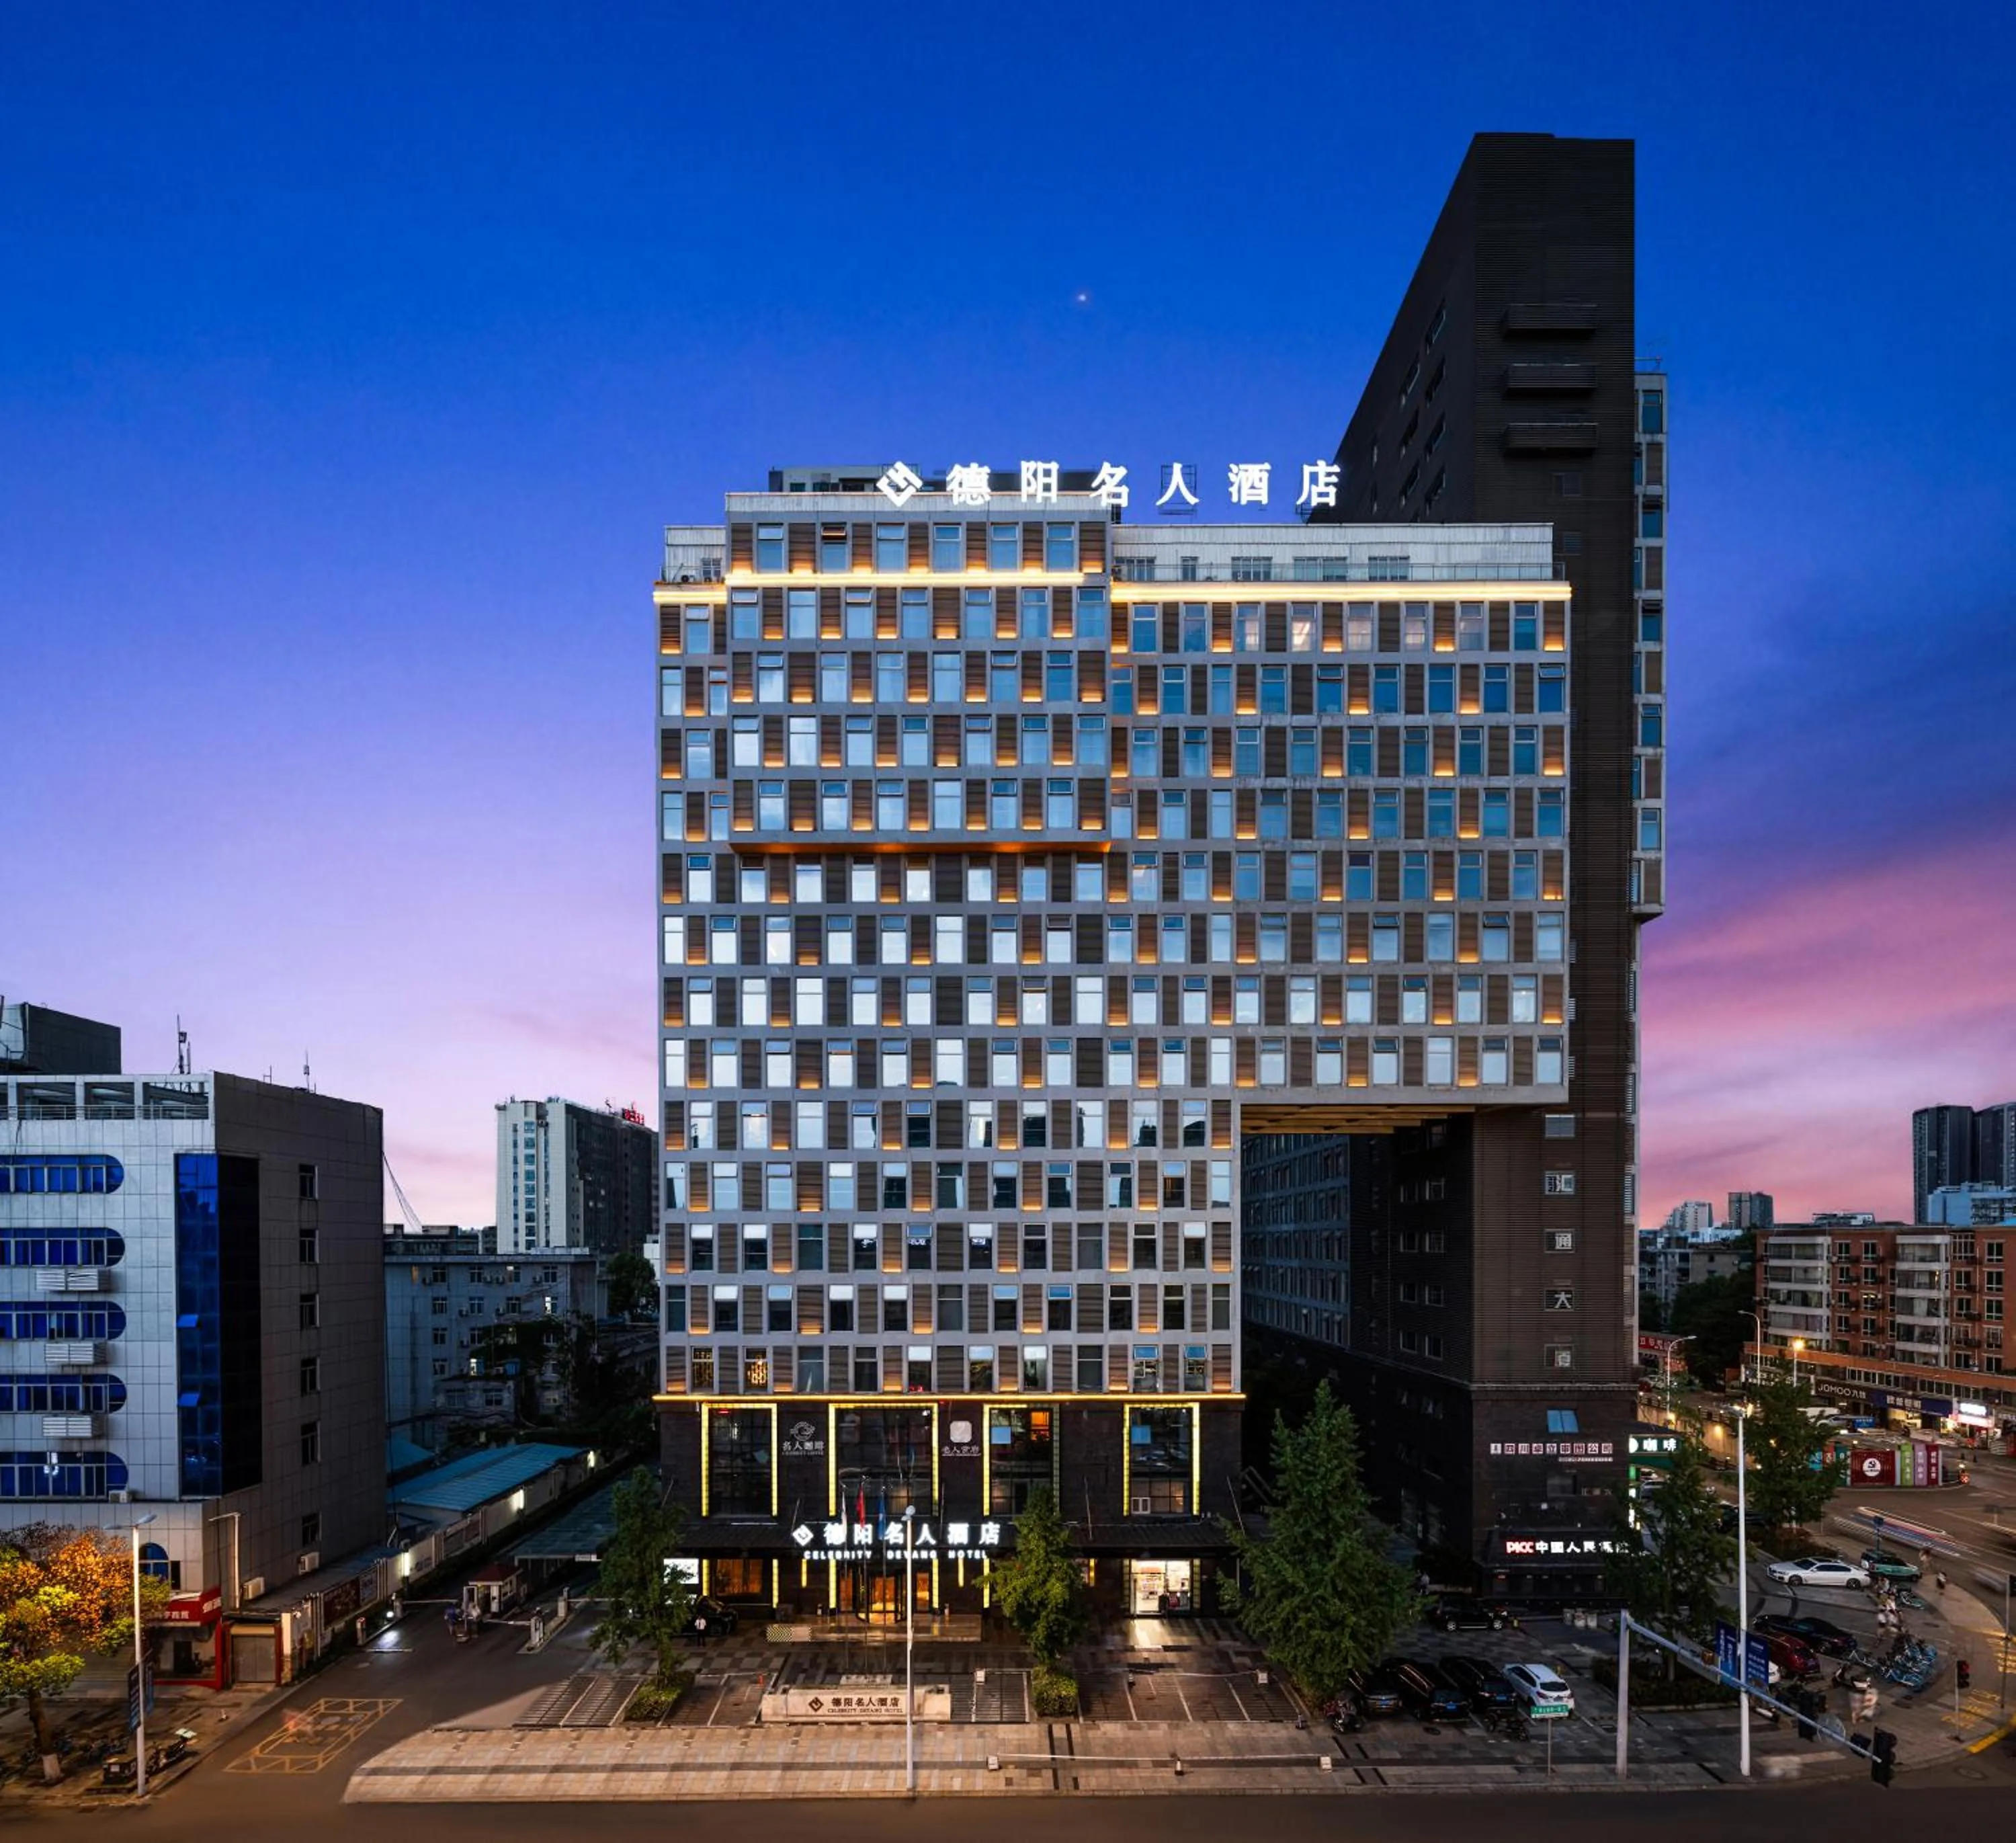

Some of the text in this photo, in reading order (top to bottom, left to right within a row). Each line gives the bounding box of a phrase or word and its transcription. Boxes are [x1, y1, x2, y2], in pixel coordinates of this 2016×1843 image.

[946, 460, 1341, 507] 德阳名人酒店
[1818, 1383, 1851, 1396] JOMOO
[782, 1440, 825, 1451] 名人咖啡
[1643, 1437, 1677, 1452] 咖啡
[824, 1522, 1001, 1545] 德阳名人酒店
[1505, 1541, 1534, 1554] PICC
[804, 1550, 988, 1560] CELEBRITY DEYANG HOTEL
[831, 1696, 900, 1707] 德阳名人酒店
